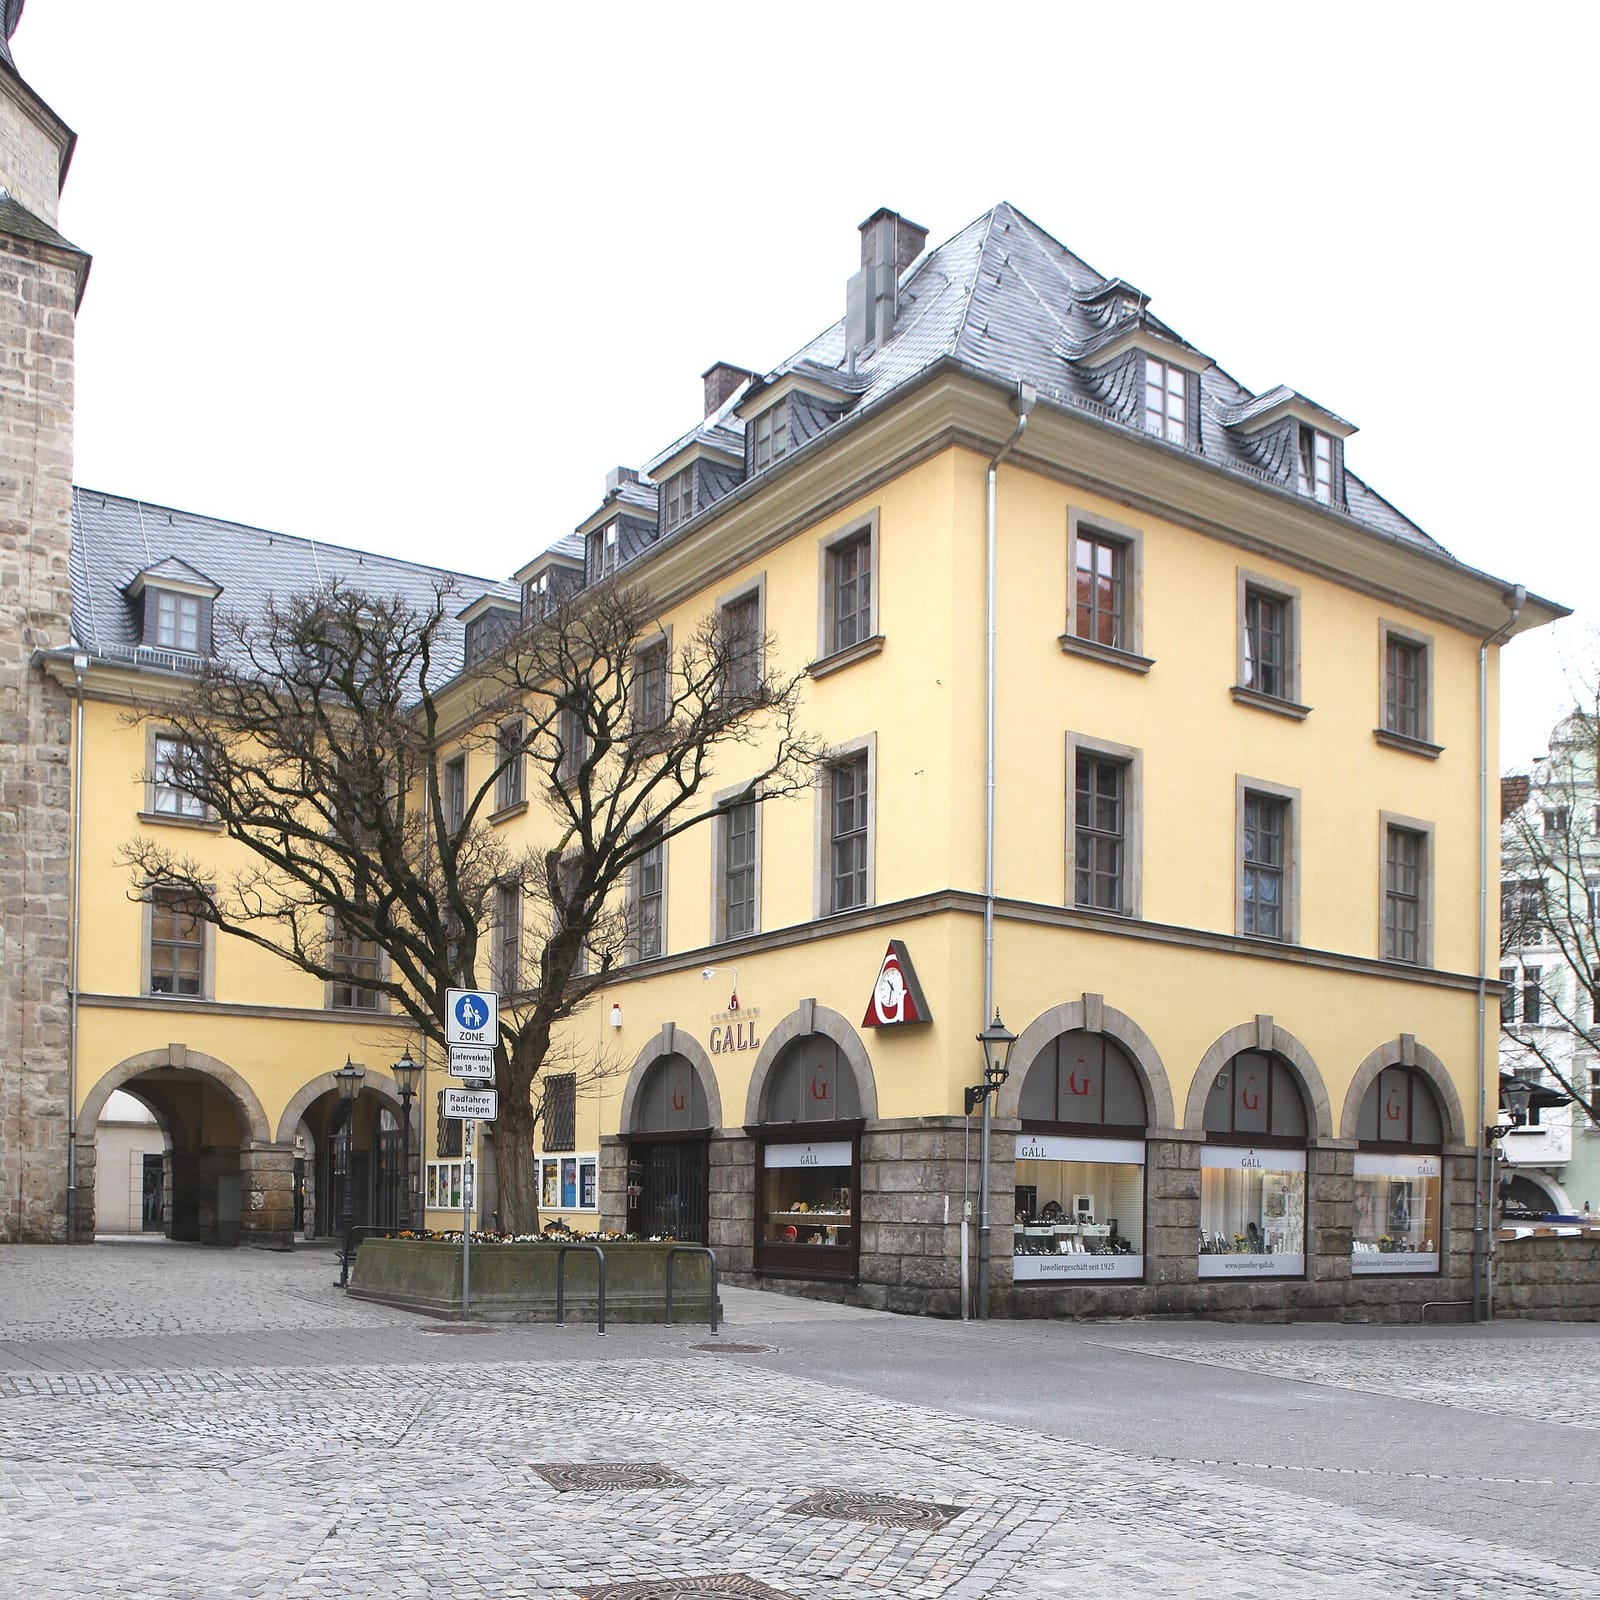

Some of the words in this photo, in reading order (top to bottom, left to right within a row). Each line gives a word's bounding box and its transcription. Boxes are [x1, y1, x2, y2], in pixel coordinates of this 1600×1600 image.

[459, 1031, 485, 1042] ZONE
[709, 1020, 760, 1055] GALL
[453, 1052, 490, 1062] Lieferverkehr
[452, 1064, 464, 1072] von
[465, 1064, 474, 1072] 18
[450, 1095, 491, 1105] Radfahrer
[450, 1104, 490, 1115] absteigen
[1021, 1146, 1047, 1158] GALL
[800, 1155, 819, 1165] GALL
[1241, 1158, 1262, 1168] GALL
[1417, 1166, 1435, 1175] GALL
[1088, 1263, 1099, 1271] seit
[1100, 1262, 1115, 1271] 1925
